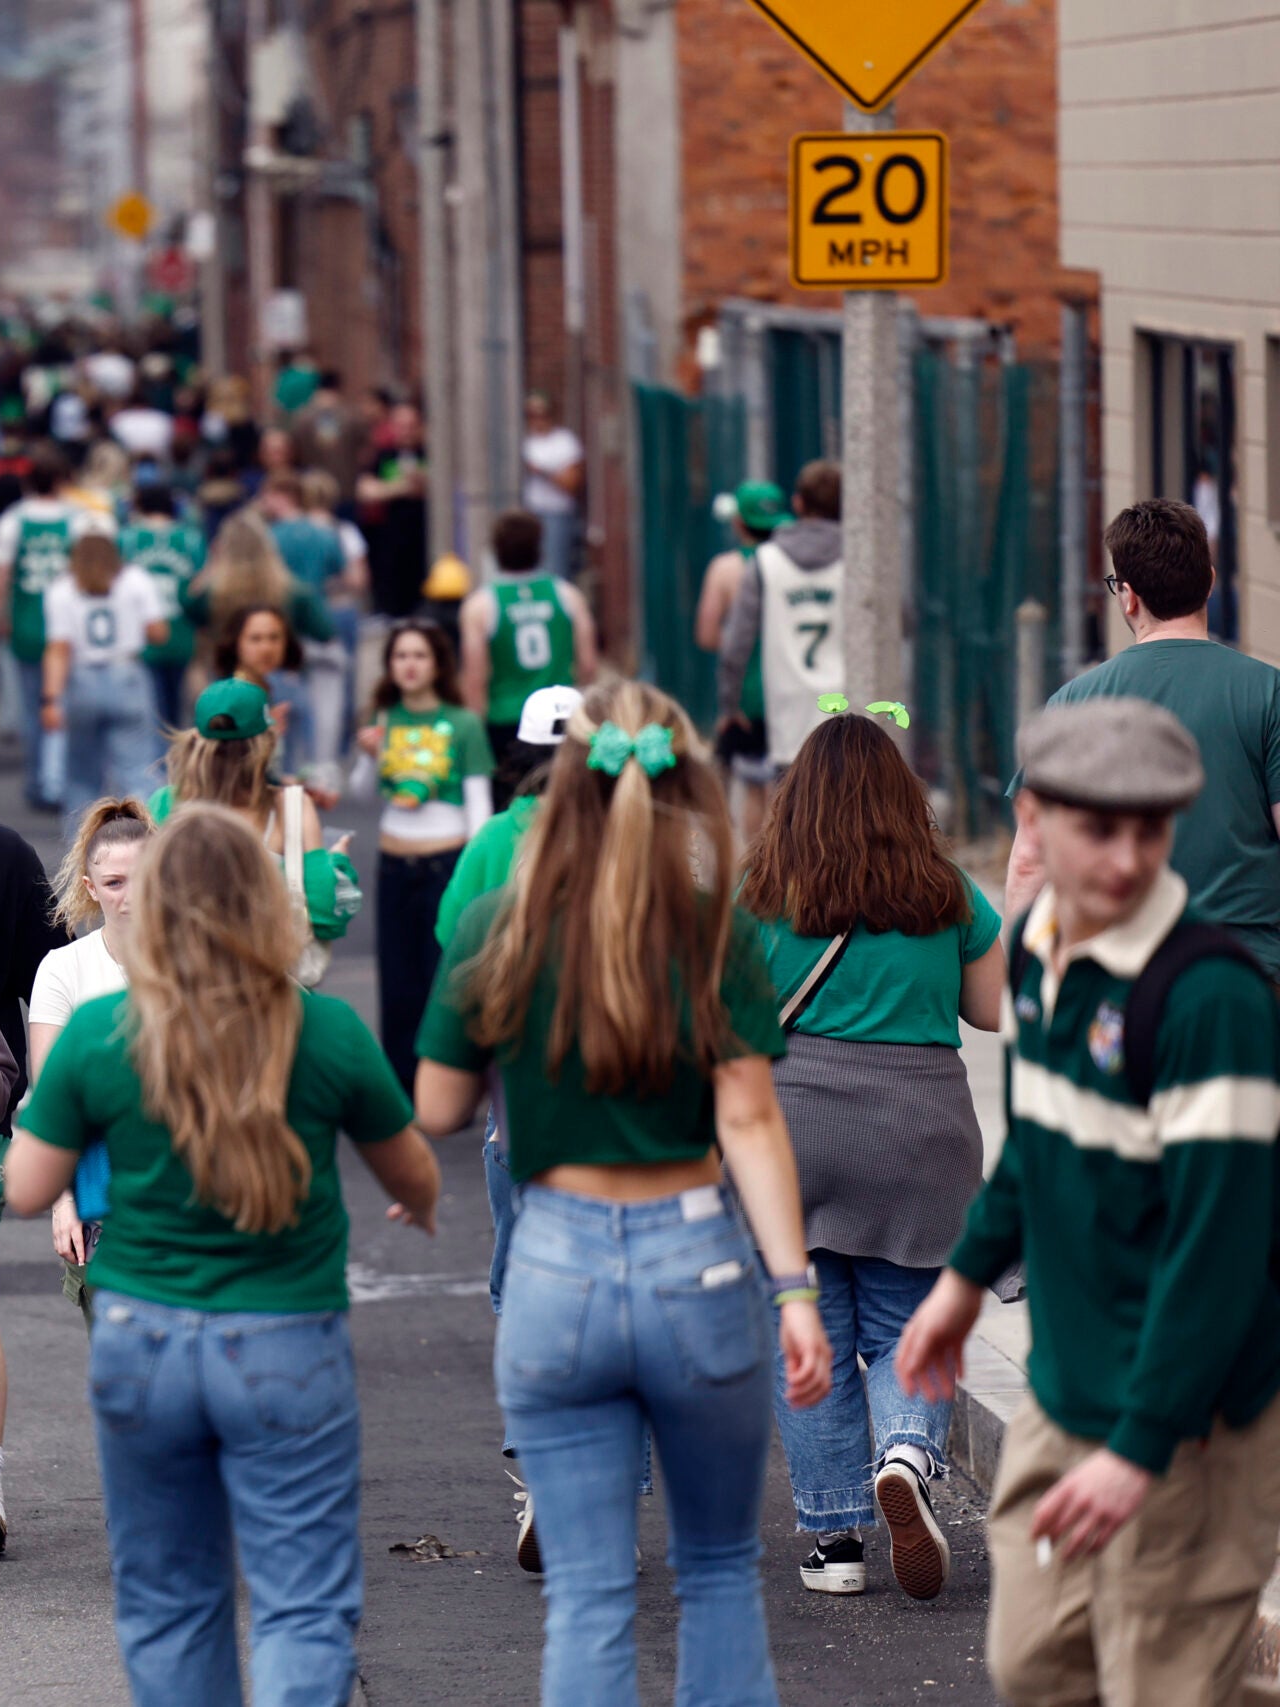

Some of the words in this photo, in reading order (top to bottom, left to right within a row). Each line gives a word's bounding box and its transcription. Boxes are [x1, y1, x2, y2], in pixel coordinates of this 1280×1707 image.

[812, 154, 926, 224] 20
[828, 240, 909, 265] MPH
[515, 623, 551, 669] 0
[797, 622, 829, 669] 7
